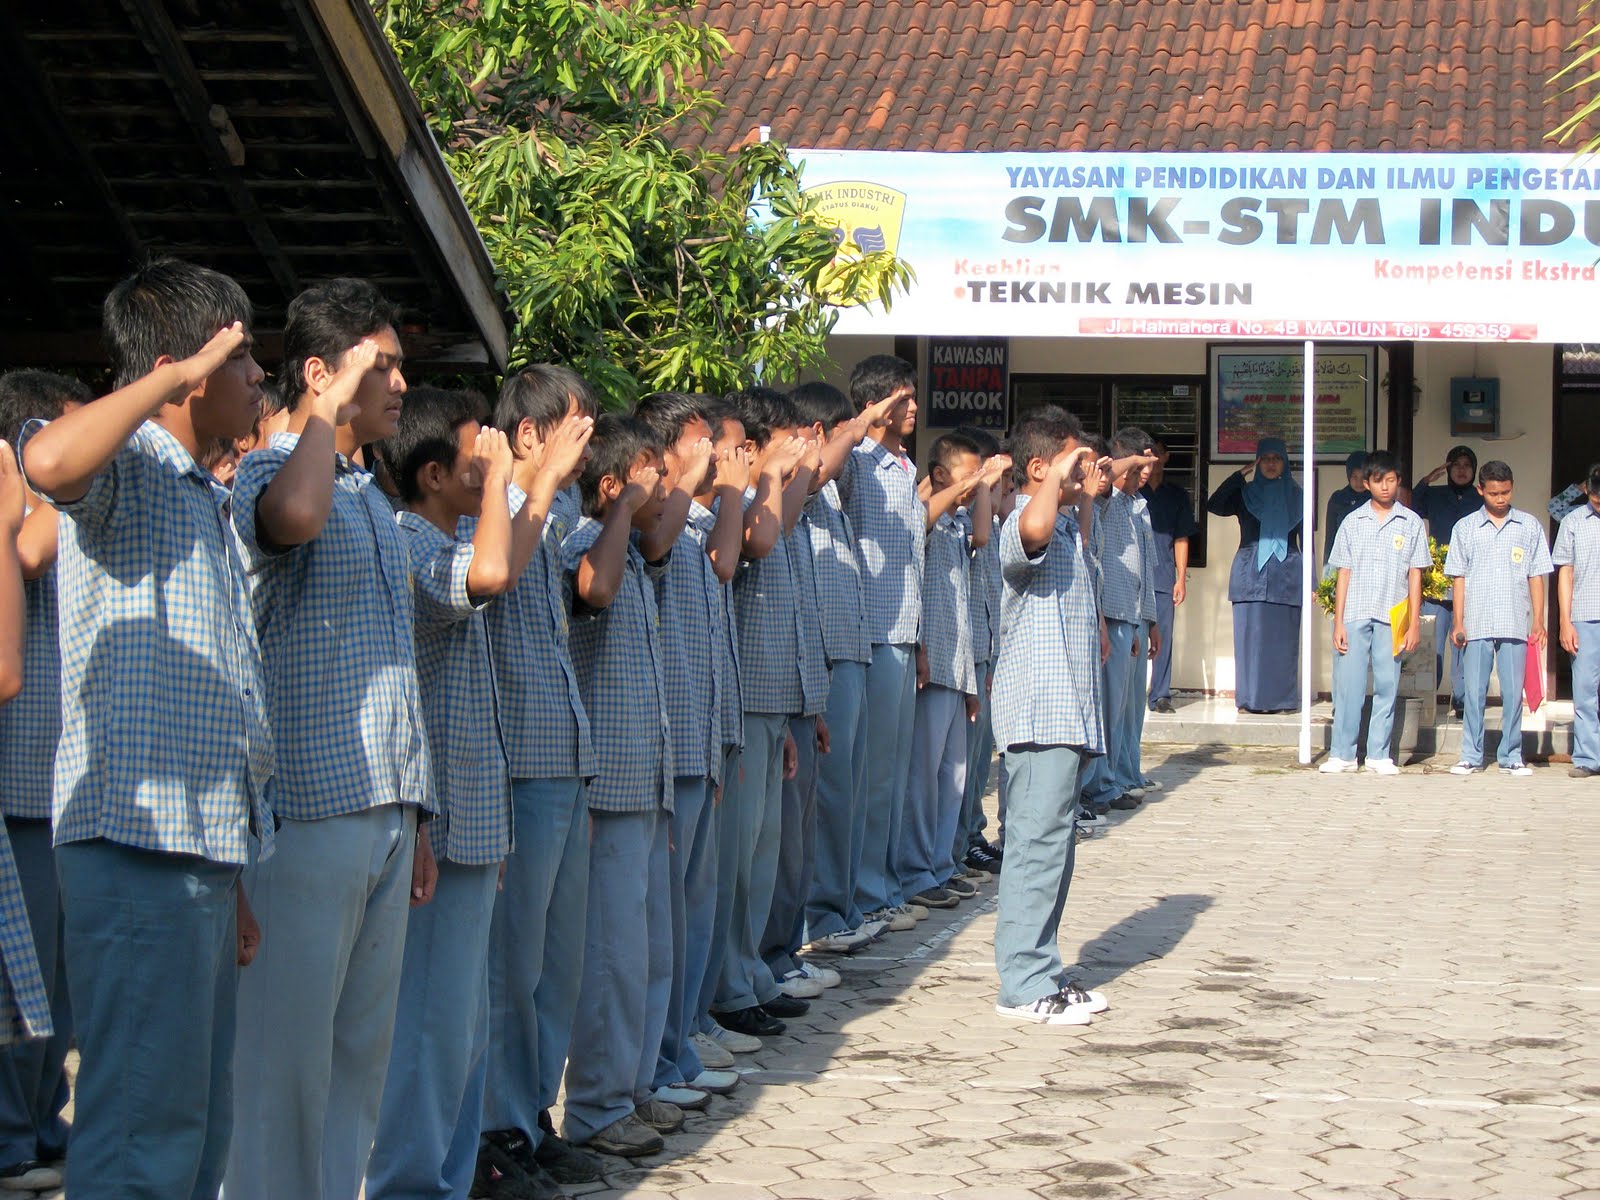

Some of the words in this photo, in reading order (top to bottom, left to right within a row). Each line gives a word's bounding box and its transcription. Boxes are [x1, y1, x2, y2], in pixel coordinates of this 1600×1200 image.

[1006, 166, 1124, 188] YAYASAN
[1135, 167, 1307, 189] PENDIDIKAN
[1317, 167, 1375, 189] DAN
[1387, 168, 1456, 190] ILMU
[821, 201, 849, 212] STATUS
[837, 188, 895, 206] INDUSTRI
[1001, 196, 1386, 245] SMK-STM
[1374, 258, 1513, 285] Kompetensi
[1522, 259, 1596, 281] Ekstra
[967, 280, 1111, 304] TEKNIK
[1126, 282, 1253, 306] MESIN
[1132, 319, 1232, 334] Halmahera
[1237, 320, 1267, 335] No.
[1274, 321, 1299, 335] 4B
[1305, 321, 1387, 336] MADIUN
[1393, 322, 1431, 338] Telp
[1440, 323, 1511, 338] 459359
[933, 346, 1004, 365] KAWASAN
[931, 366, 1003, 391] TANPA
[932, 390, 1003, 411] ROKOK
